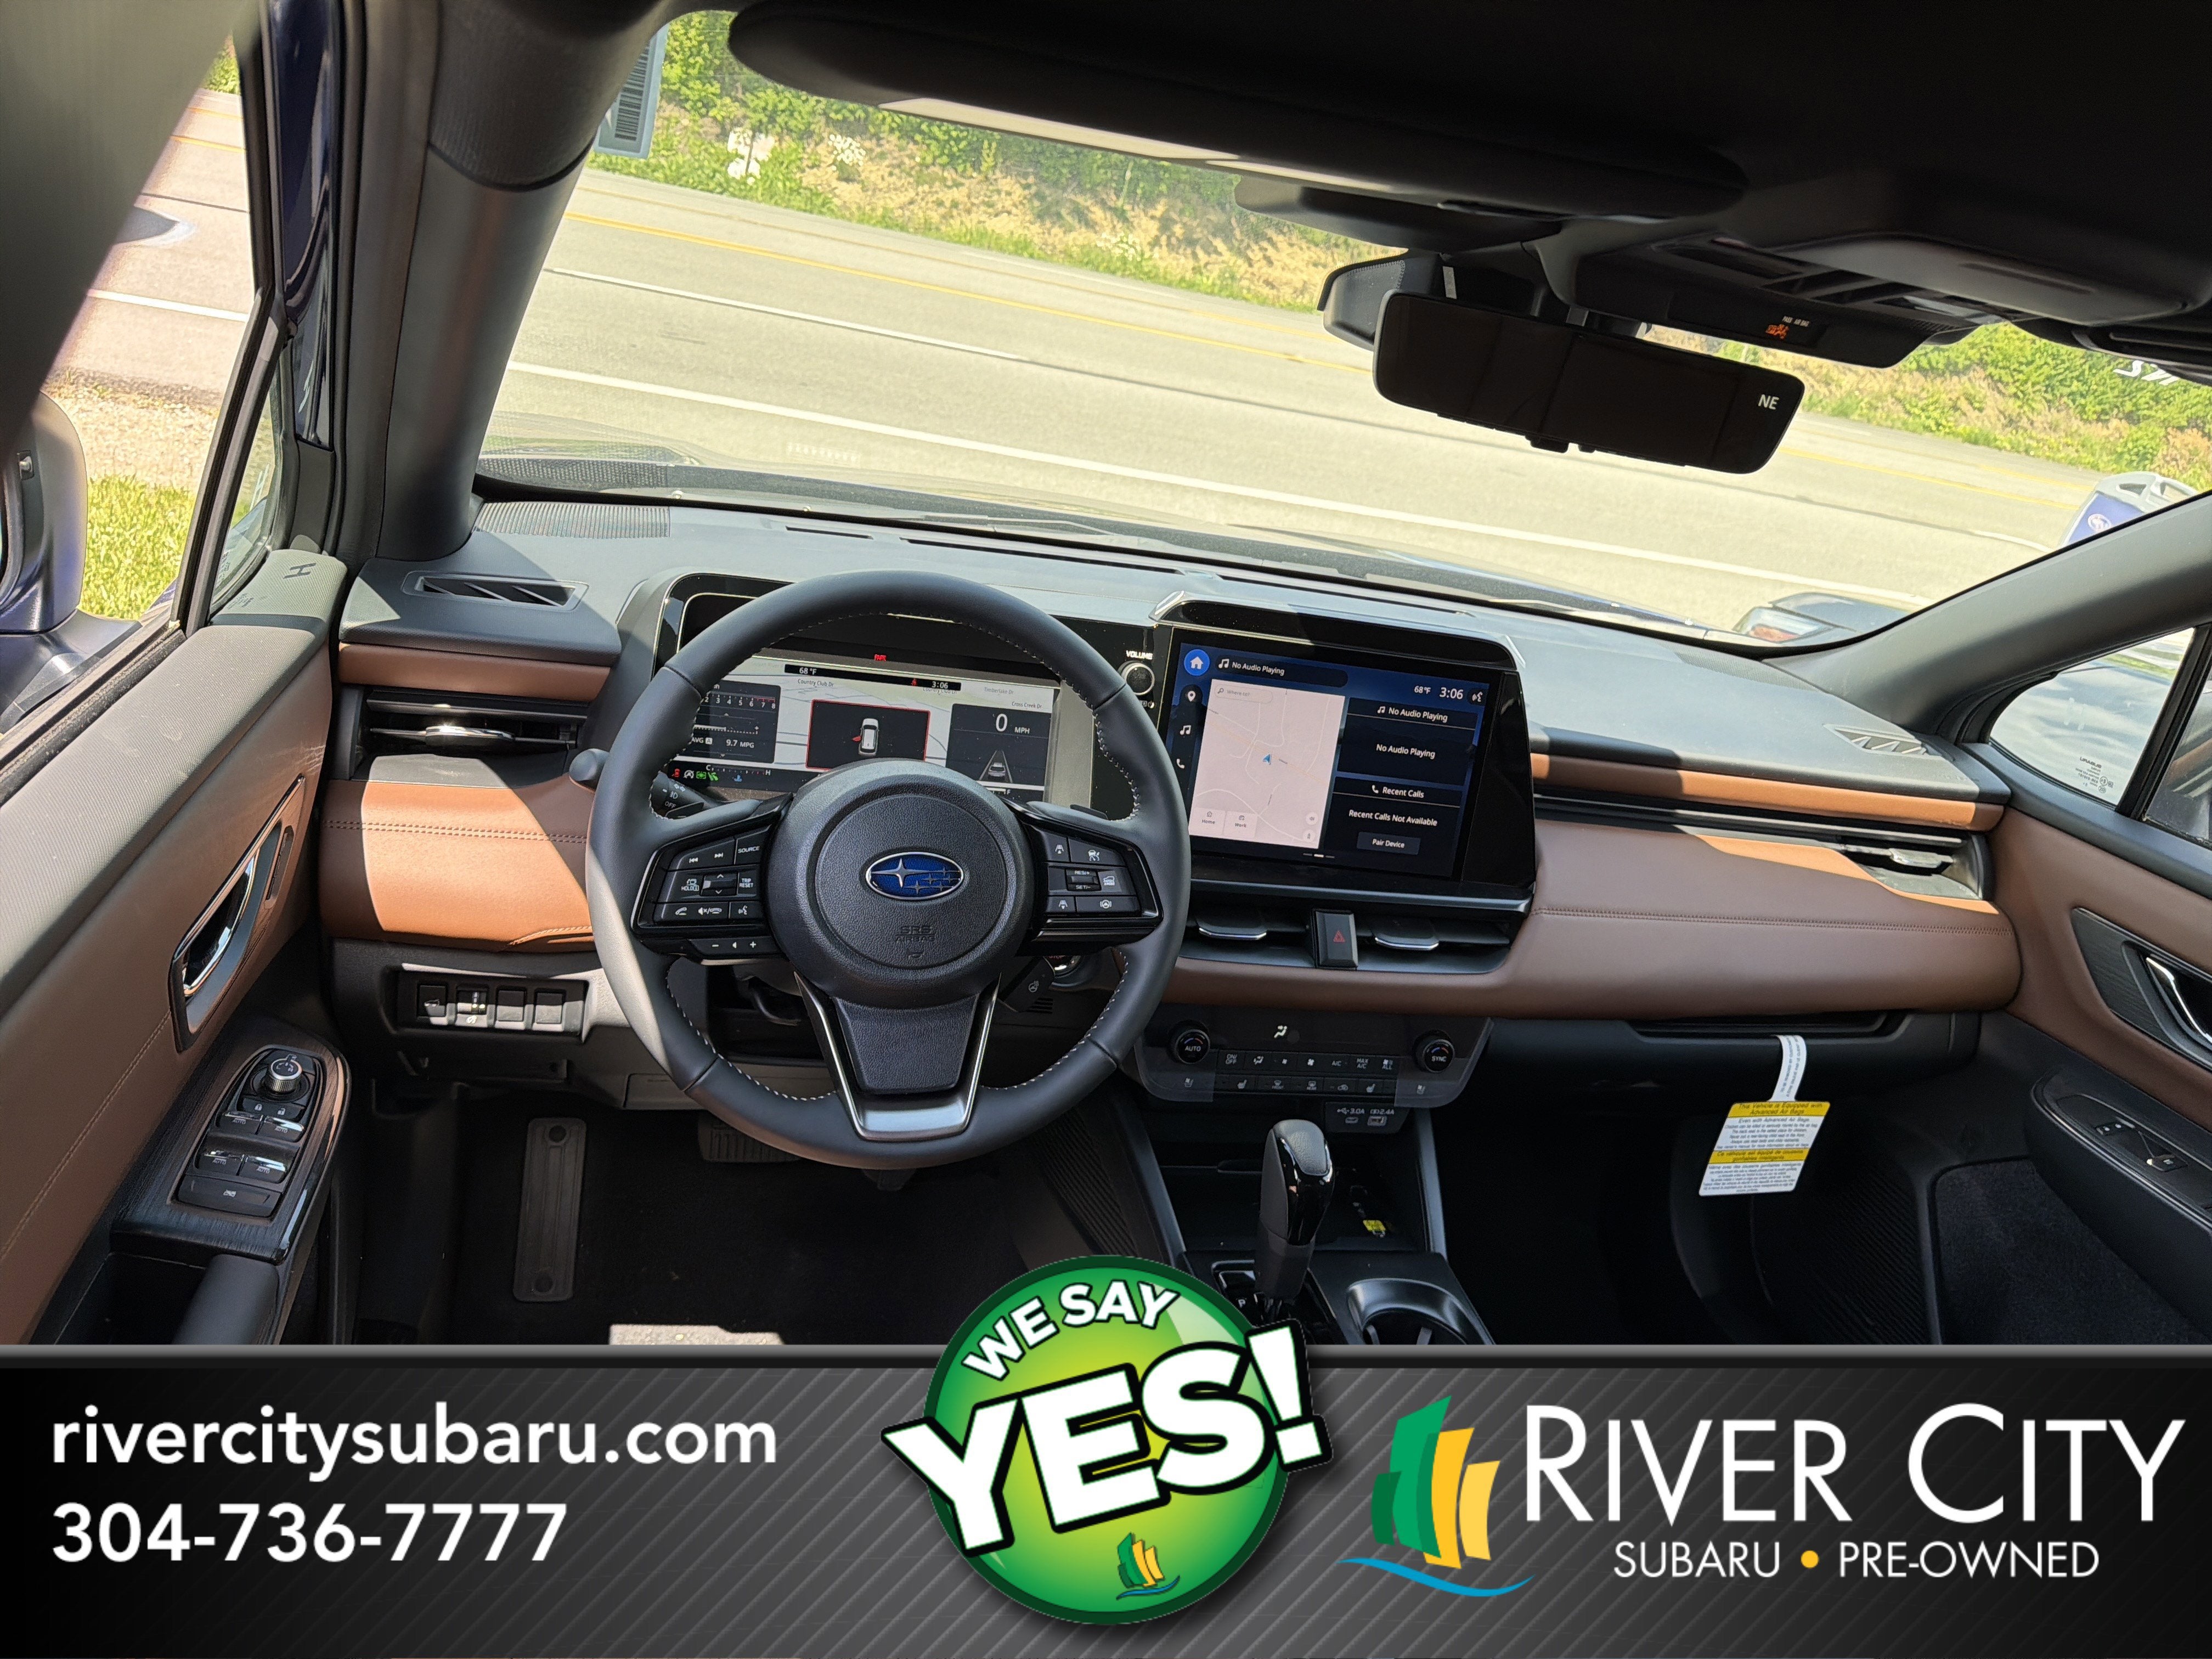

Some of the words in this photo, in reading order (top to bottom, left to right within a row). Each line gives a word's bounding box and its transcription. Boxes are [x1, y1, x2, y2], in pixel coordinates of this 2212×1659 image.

[1758, 394, 1779, 410] NE
[1126, 650, 1153, 660] VOLUME
[1232, 661, 1241, 669] No
[1243, 662, 1261, 672] Audio
[1262, 665, 1284, 676] Playing
[798, 679, 816, 687] Country
[1414, 685, 1430, 694] 68°F
[1439, 686, 1463, 700] 3:06
[1388, 706, 1398, 715] No
[1400, 708, 1421, 718] Audio
[1423, 710, 1447, 723] Playing
[996, 713, 1007, 732] 0
[1376, 743, 1386, 752] No
[1387, 745, 1408, 755] Audio
[1410, 747, 1435, 759] Playing
[1382, 786, 1406, 797] Recent
[1407, 788, 1424, 798] Calls
[1349, 809, 1373, 820] Recent
[1374, 811, 1391, 822] Calls
[1392, 813, 1405, 822] Not
[1406, 815, 1437, 826] Available
[1372, 838, 1384, 847] Pair
[1385, 840, 1404, 849] Device
[1238, 1299, 1246, 1308] P
